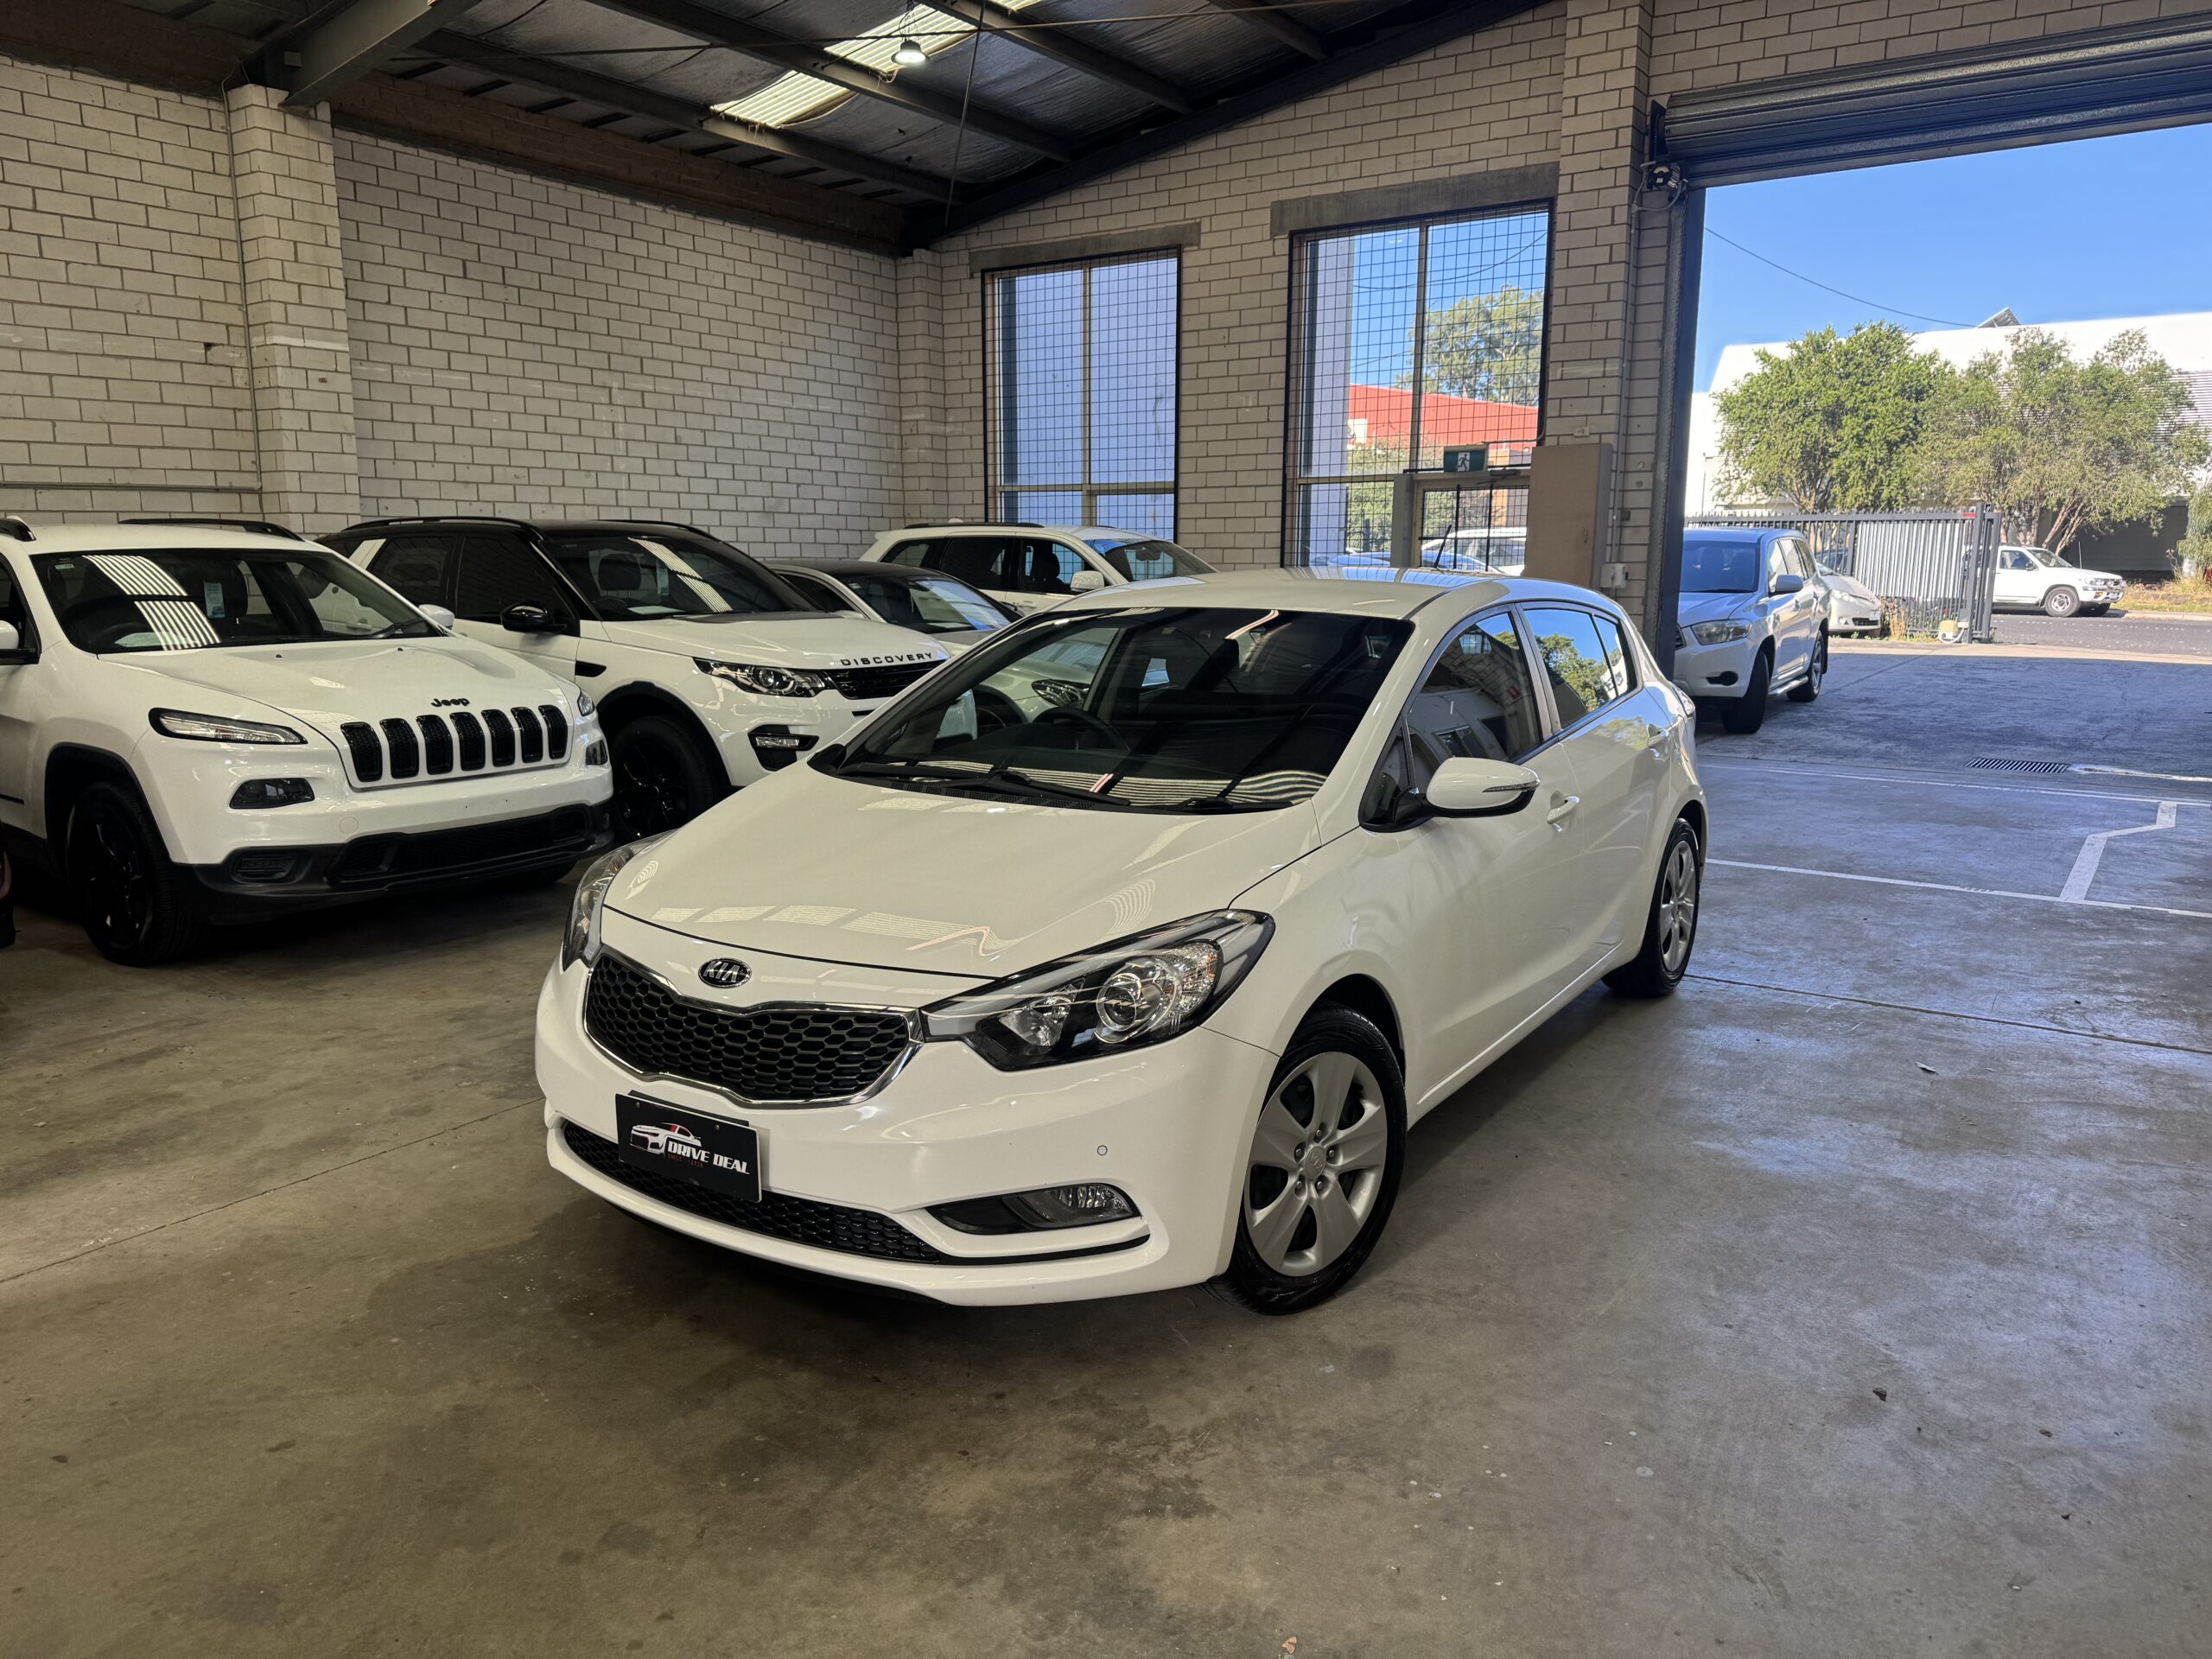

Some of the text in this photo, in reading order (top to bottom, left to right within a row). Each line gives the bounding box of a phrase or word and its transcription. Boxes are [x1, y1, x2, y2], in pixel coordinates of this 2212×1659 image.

[840, 652, 932, 665] DISCOVERY
[431, 697, 470, 708] Jeep
[703, 961, 740, 982] KIA
[668, 1141, 710, 1163] DRIVE
[713, 1154, 750, 1174] DEAL
